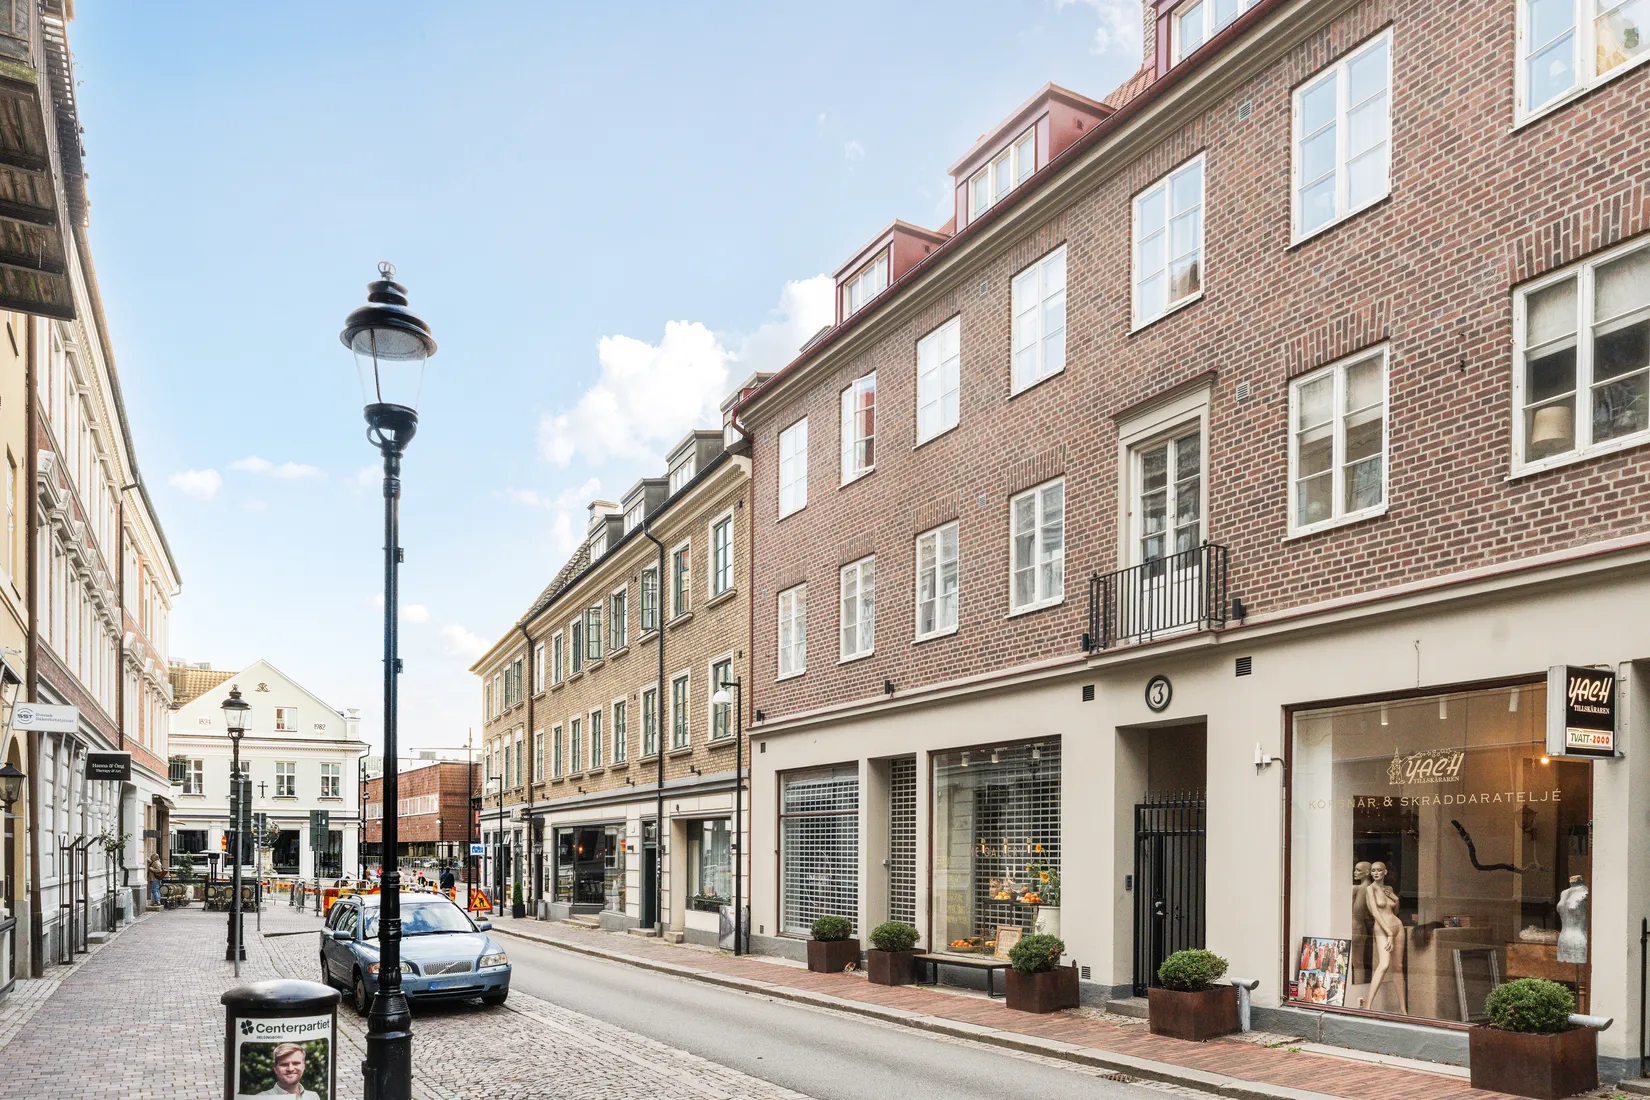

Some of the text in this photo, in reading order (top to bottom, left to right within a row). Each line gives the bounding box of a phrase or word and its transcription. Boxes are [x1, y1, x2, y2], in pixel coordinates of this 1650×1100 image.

[1153, 683, 1164, 704] 3
[1568, 677, 1612, 706] YACH
[1574, 704, 1610, 714] TILLSKÄRAREN
[1406, 752, 1465, 784] YACH
[1383, 795, 1393, 807] &
[1400, 789, 1562, 807] SKRÄDDARATELJÉ
[256, 1019, 330, 1034] Centerpartiet
